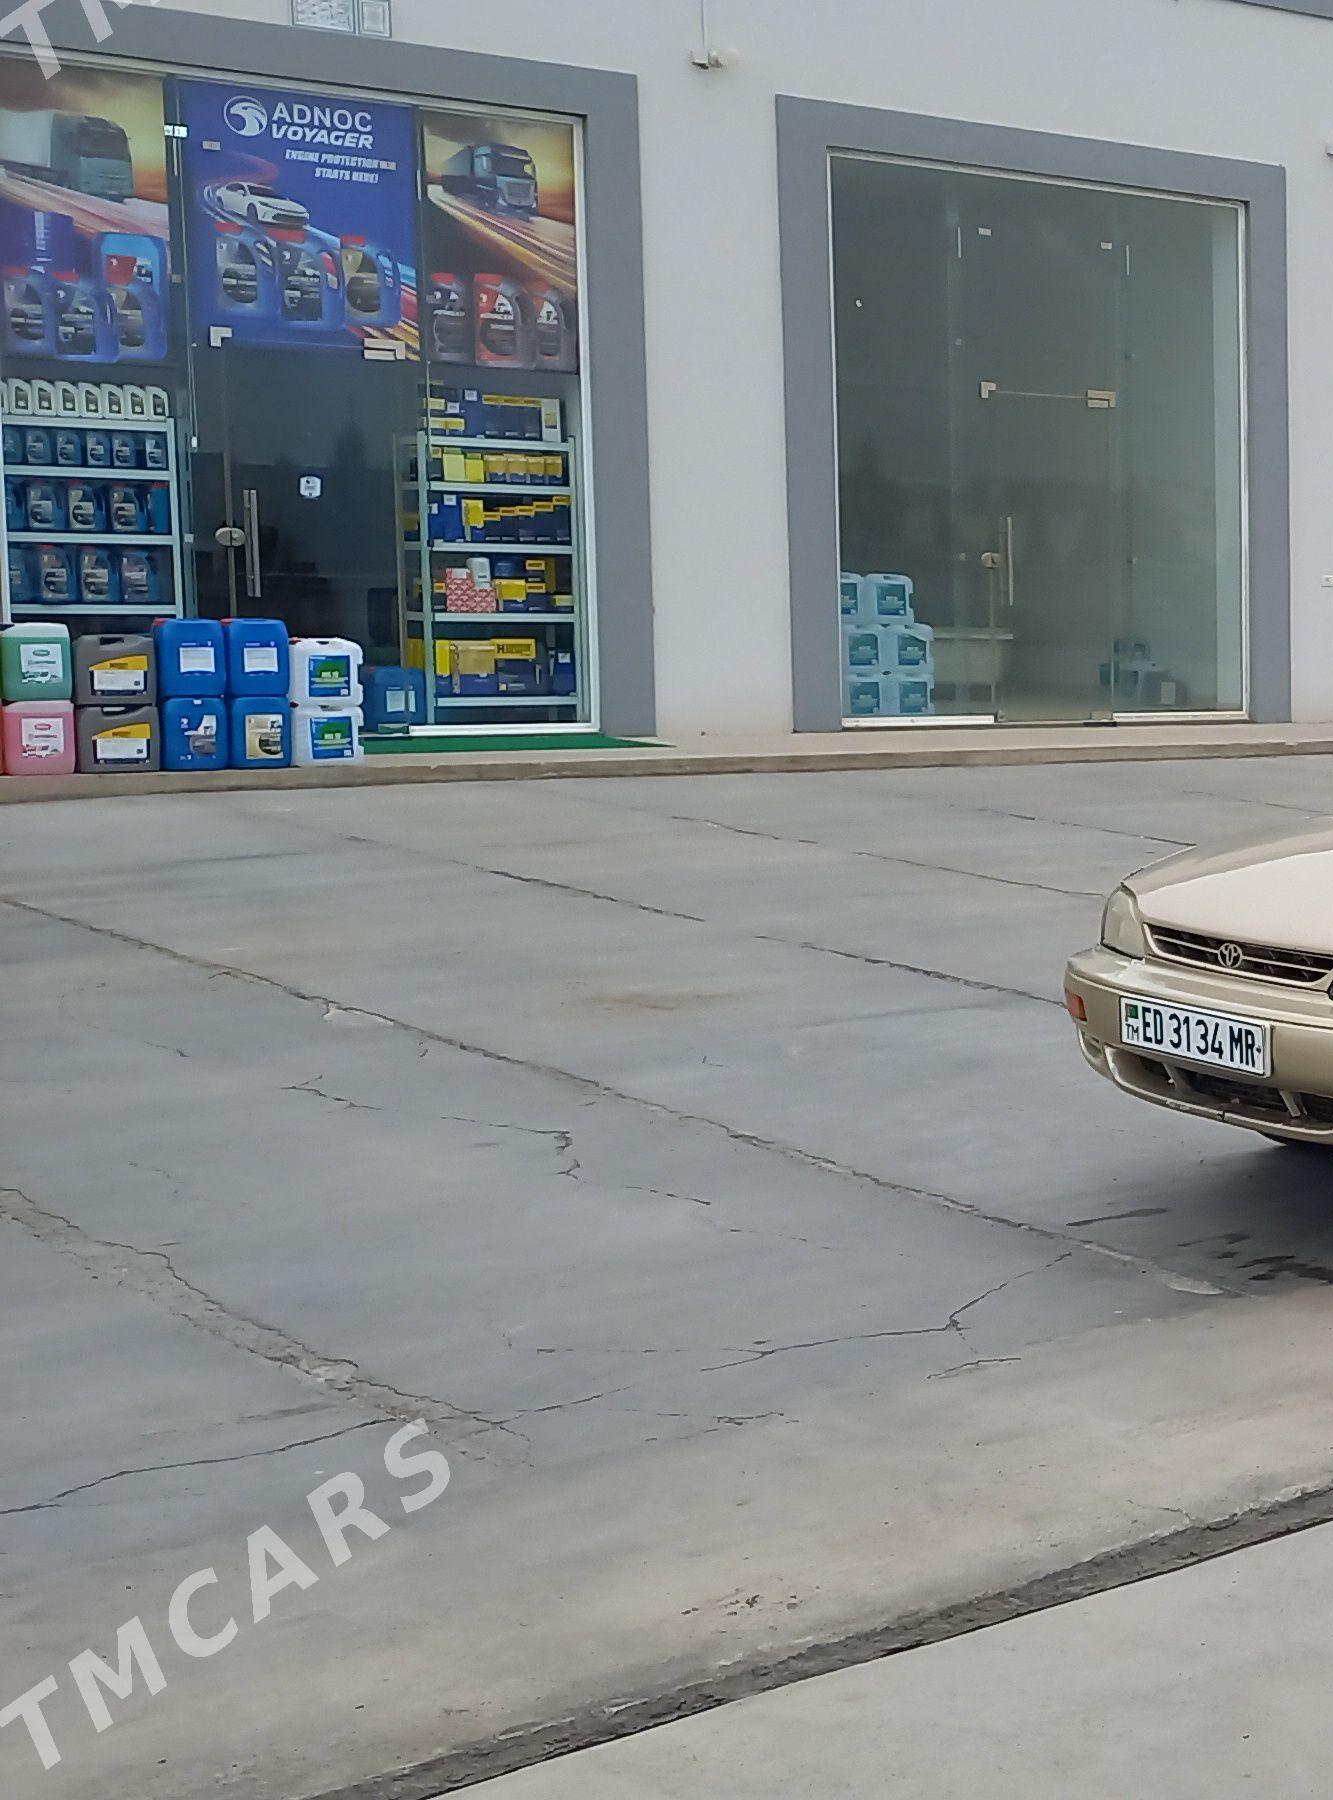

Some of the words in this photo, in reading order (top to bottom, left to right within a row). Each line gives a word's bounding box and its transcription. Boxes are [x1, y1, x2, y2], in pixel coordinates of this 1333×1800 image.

[272, 102, 373, 132] ADNOC
[271, 123, 373, 150] VOYAGER
[285, 149, 319, 164] ENGINE
[1125, 1023, 1139, 1042] TM
[1142, 1006, 1164, 1046] ED
[1168, 1013, 1223, 1060] 3134
[1229, 1025, 1256, 1068] MR
